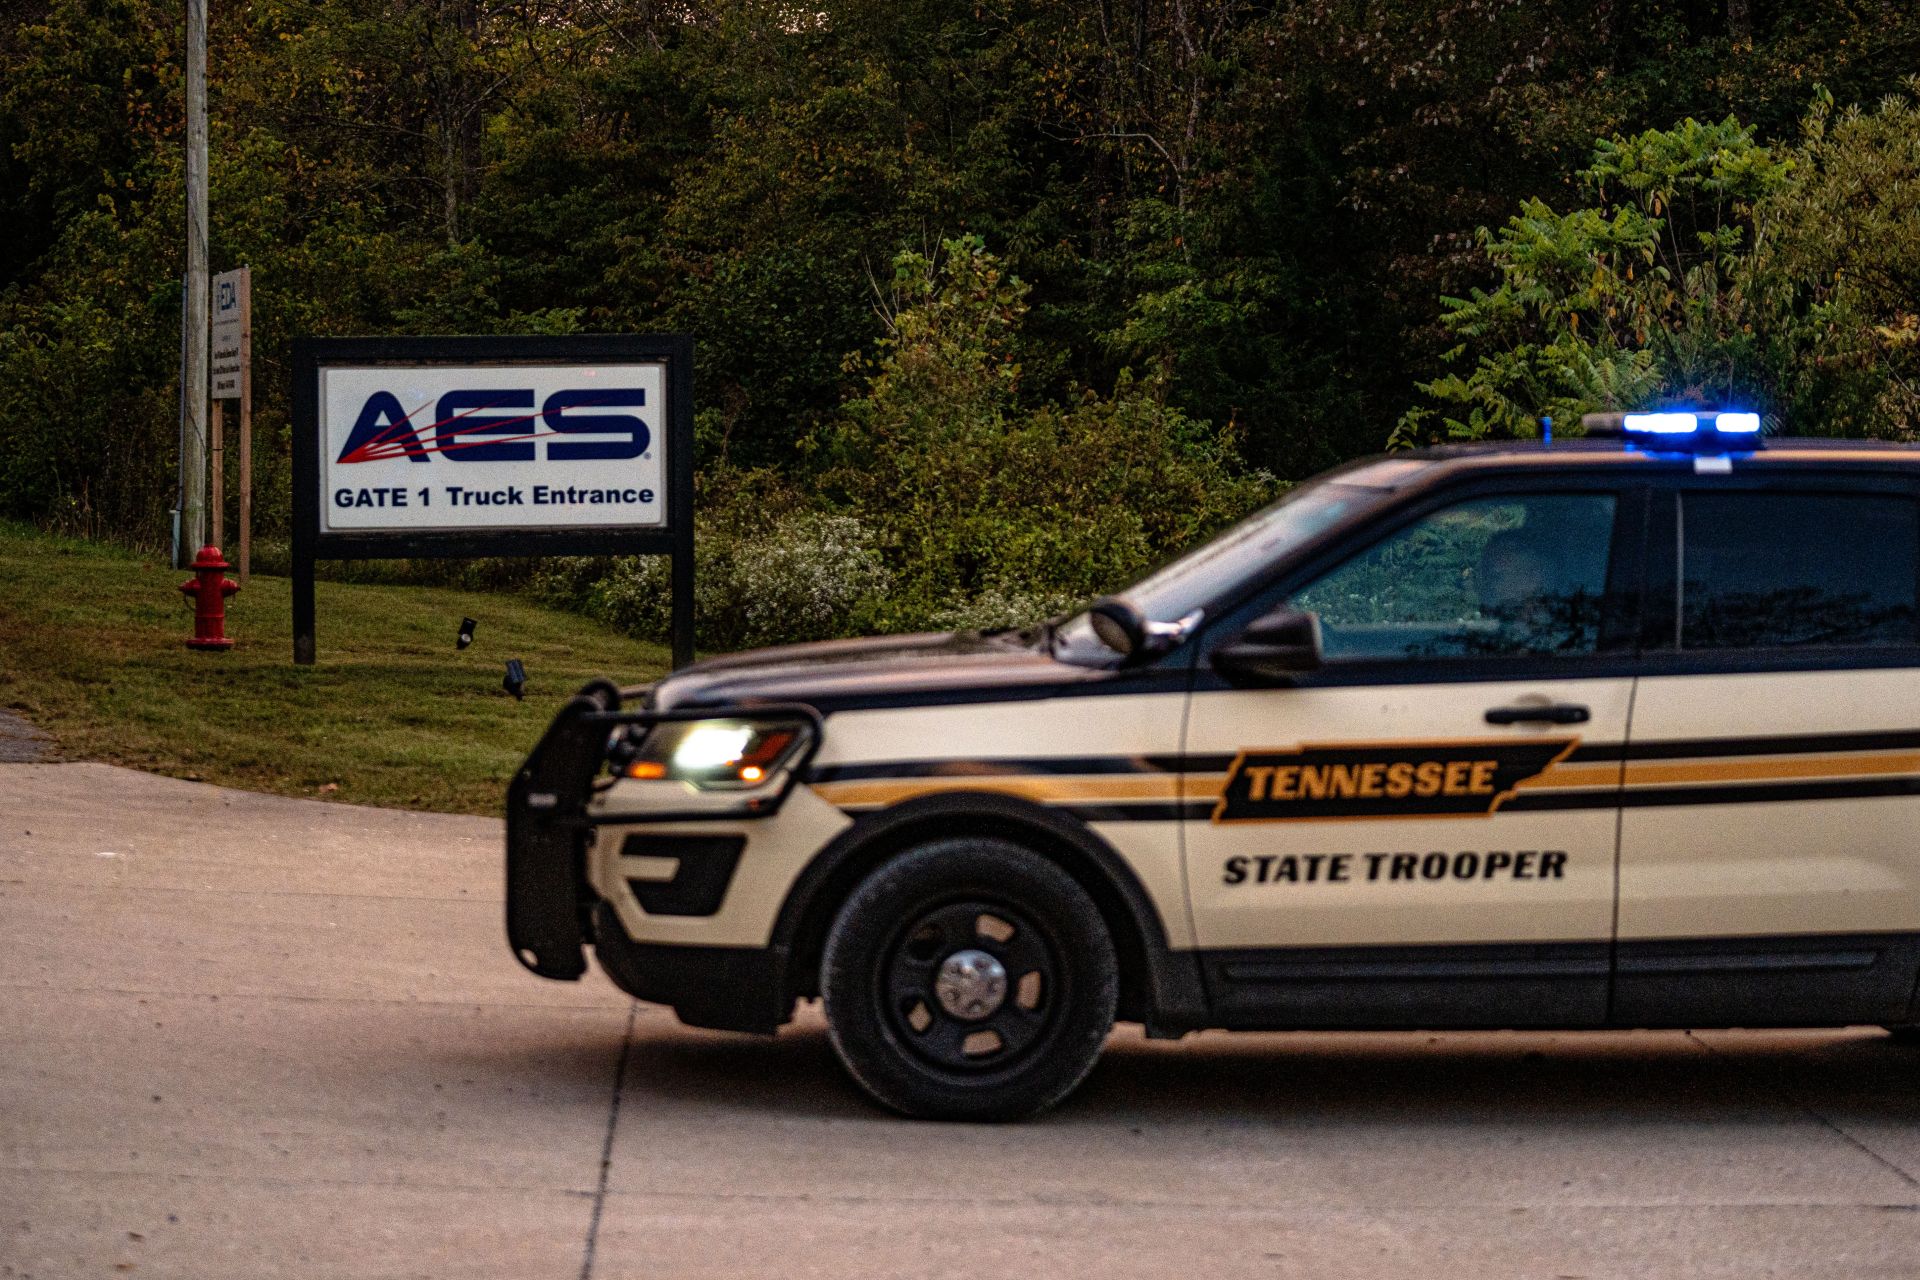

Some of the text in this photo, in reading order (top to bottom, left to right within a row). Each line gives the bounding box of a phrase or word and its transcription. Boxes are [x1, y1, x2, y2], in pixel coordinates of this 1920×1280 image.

[336, 388, 651, 464] AES
[334, 484, 655, 508] GATE 1 Truck Entrance
[1244, 760, 1499, 801] TENNESSEE
[1222, 850, 1568, 885] STATE TROOPER
